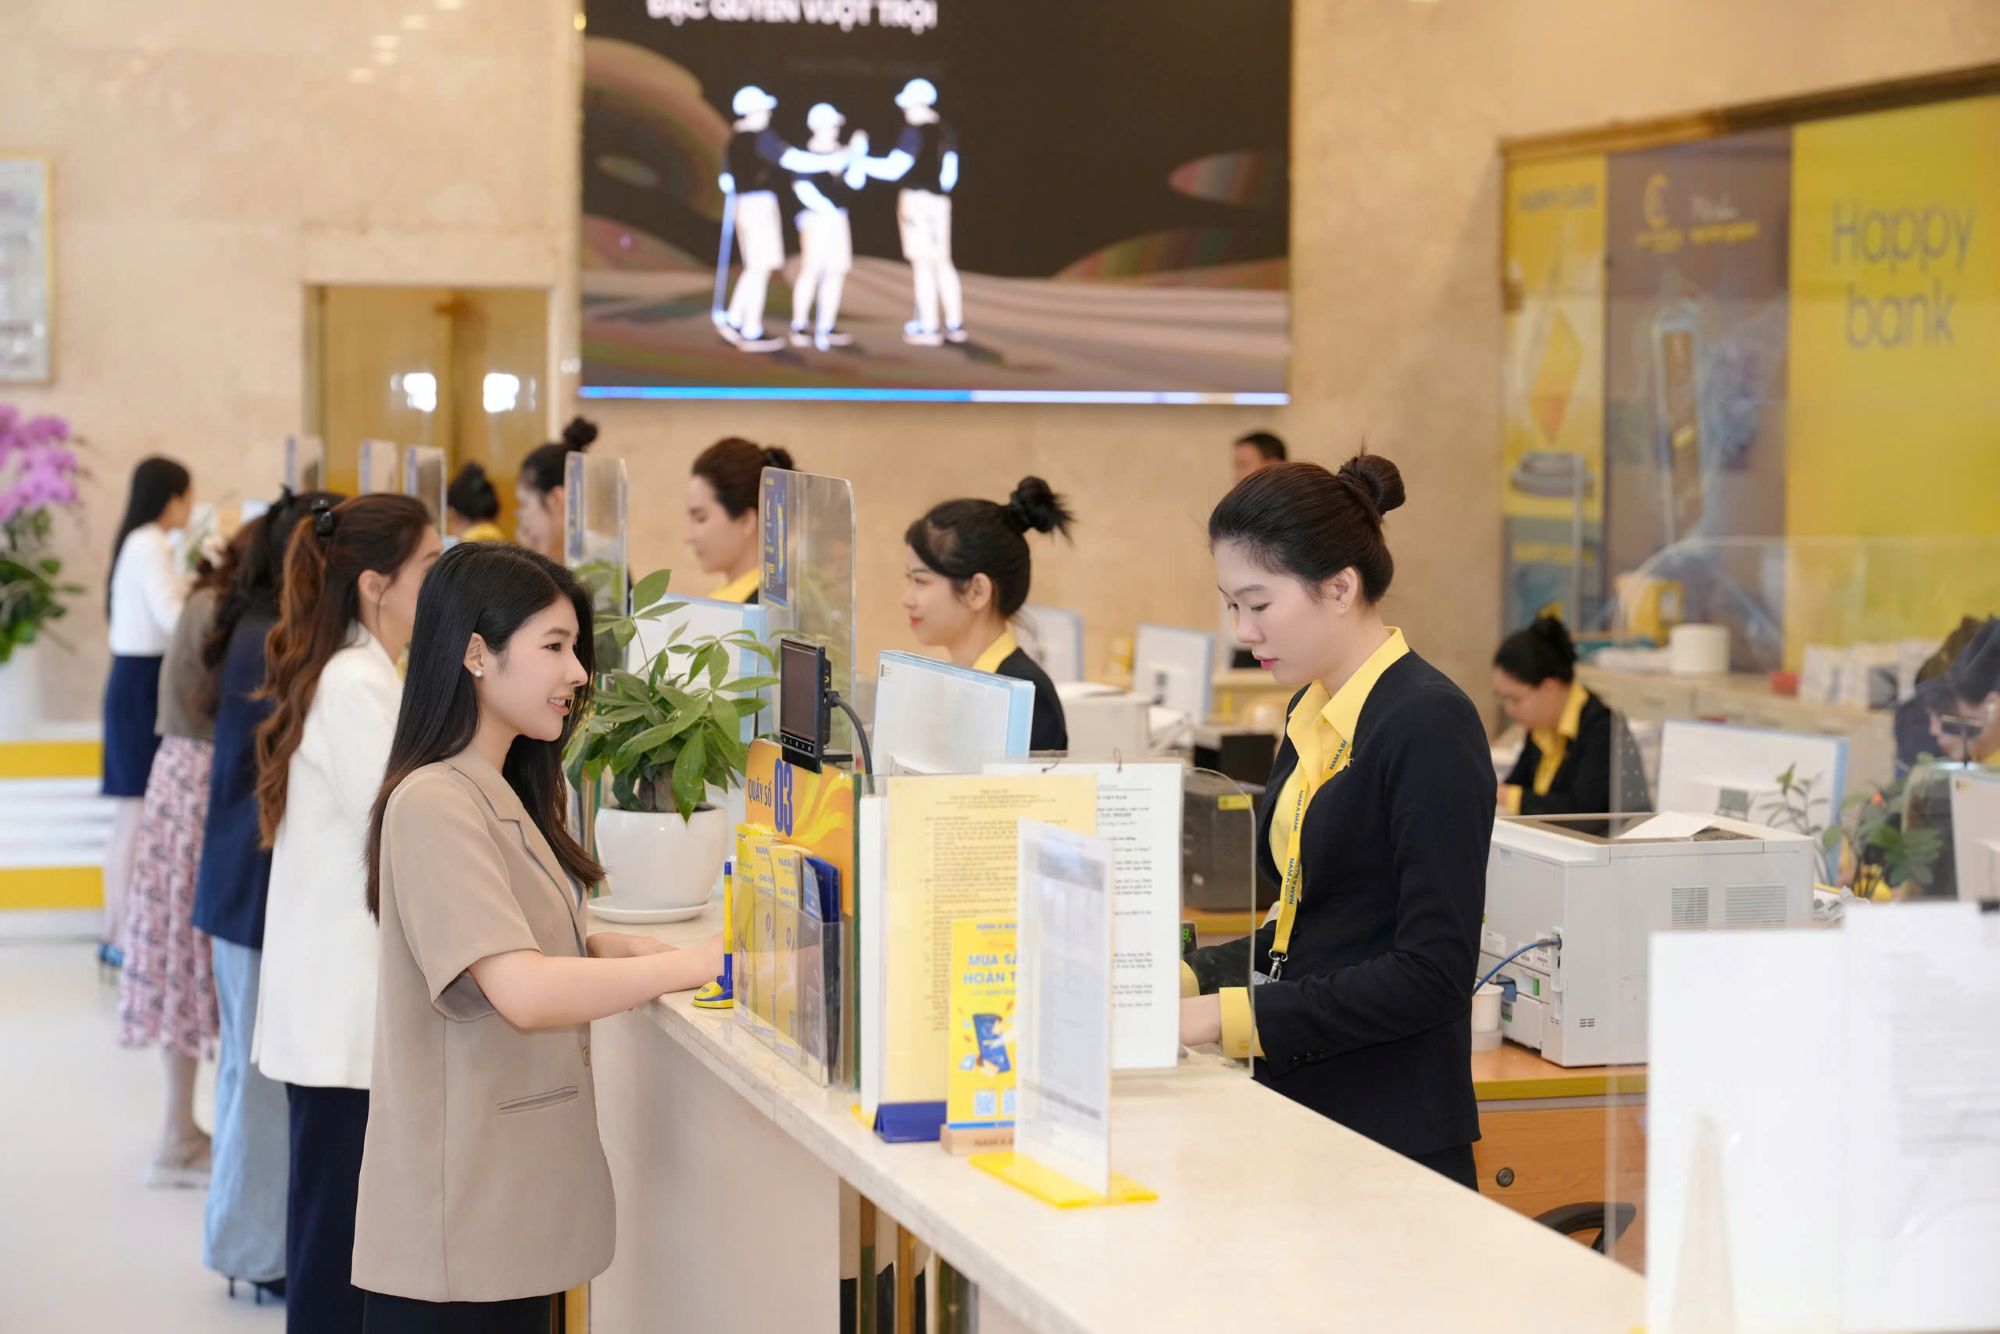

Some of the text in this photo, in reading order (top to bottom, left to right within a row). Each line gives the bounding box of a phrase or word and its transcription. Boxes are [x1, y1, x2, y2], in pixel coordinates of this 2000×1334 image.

[1831, 199, 1976, 276] Happy
[1844, 281, 1956, 350] bank
[774, 758, 793, 837] 03
[968, 953, 999, 967] MUA
